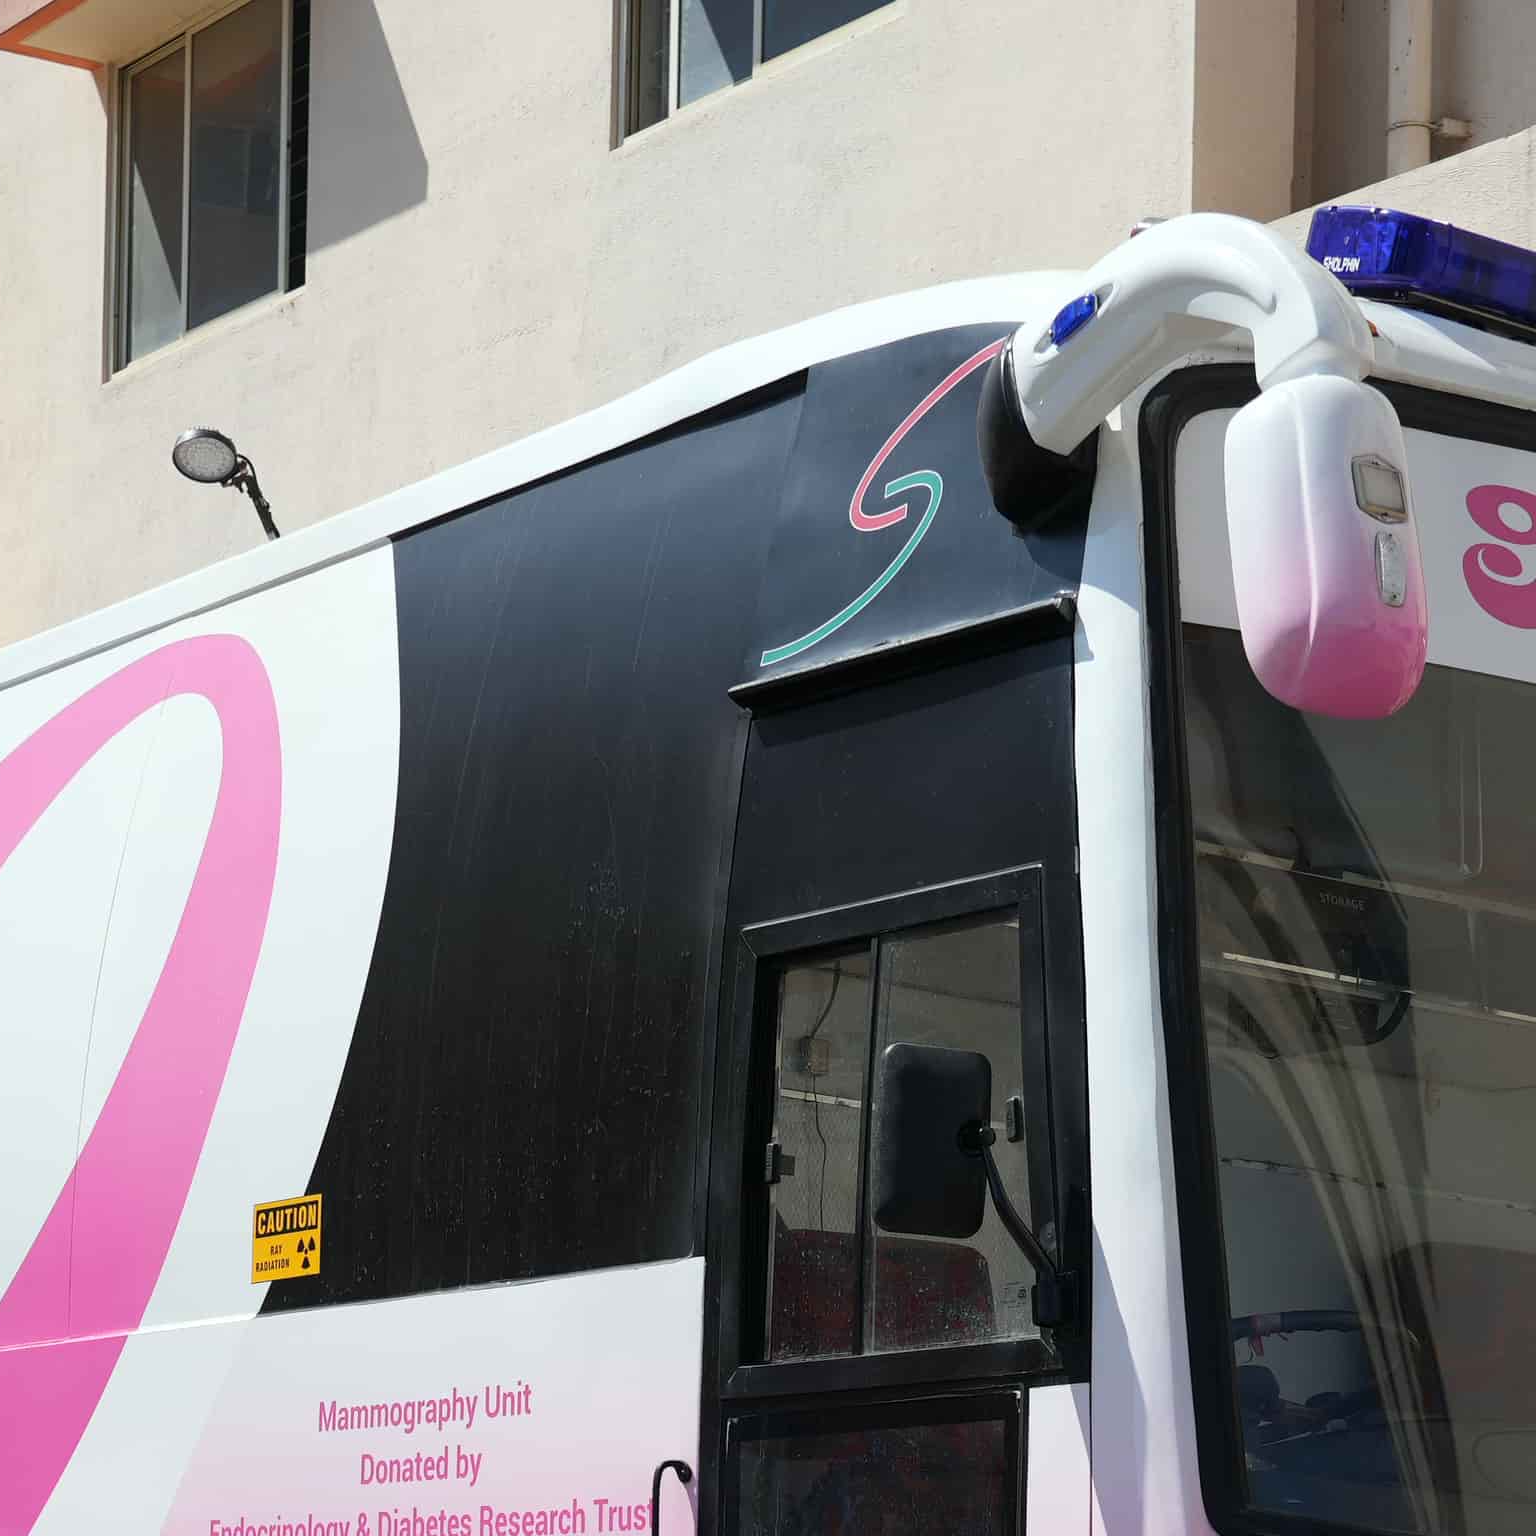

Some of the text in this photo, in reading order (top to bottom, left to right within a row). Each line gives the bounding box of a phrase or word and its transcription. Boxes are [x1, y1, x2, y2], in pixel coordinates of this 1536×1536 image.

[257, 1203, 317, 1235] CAUTION
[255, 1257, 290, 1272] RADIATION
[270, 1244, 283, 1256] RAY
[318, 1380, 532, 1434] Mammography Unit
[360, 1445, 483, 1487] Donated by
[593, 1497, 655, 1533] Trust
